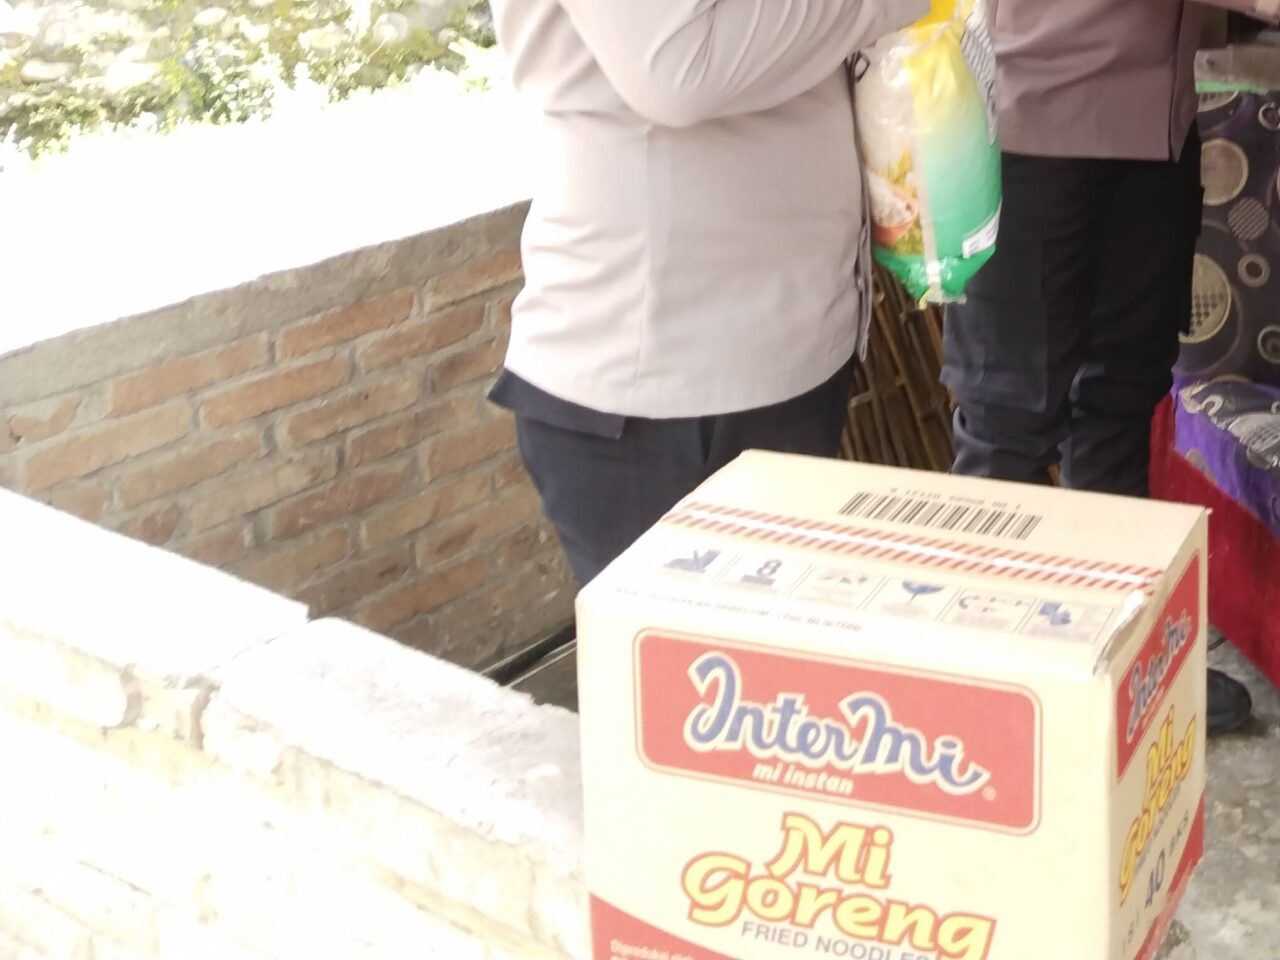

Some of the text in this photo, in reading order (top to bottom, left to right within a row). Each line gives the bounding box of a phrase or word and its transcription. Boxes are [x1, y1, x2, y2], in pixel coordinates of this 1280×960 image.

[752, 762, 854, 796] mi instan
[763, 811, 894, 889] Mi
[680, 851, 997, 960] Goreng
[741, 921, 809, 949] FRIED
